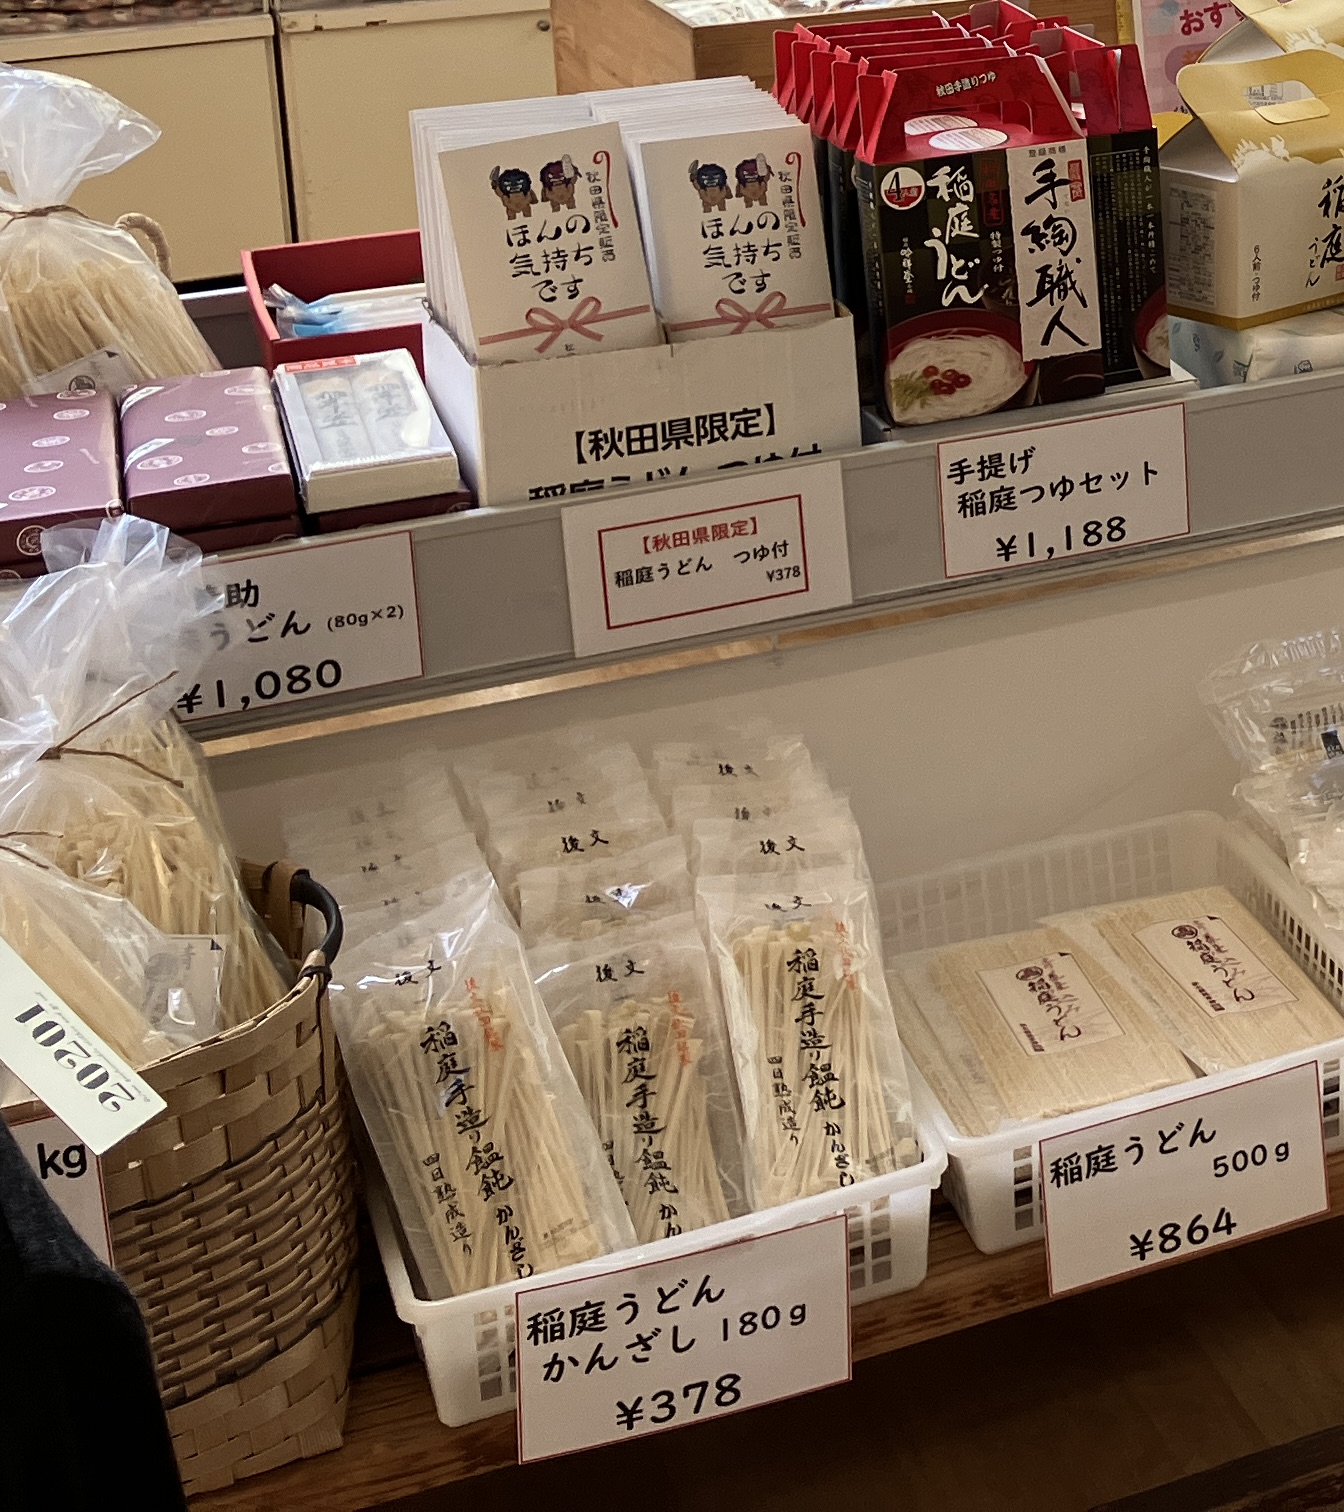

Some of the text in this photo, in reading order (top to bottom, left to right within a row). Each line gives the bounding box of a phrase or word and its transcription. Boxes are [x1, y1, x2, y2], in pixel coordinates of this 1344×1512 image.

[506, 213, 591, 247] ほんの
[702, 210, 781, 240] ほんの
[924, 165, 990, 307] 稲庭うどん
[509, 241, 595, 278] 気持ち
[703, 238, 783, 270] 気持ち
[531, 274, 584, 303] です
[722, 268, 772, 295] です
[574, 402, 777, 465] 【秋田県限定】
[946, 445, 1037, 485] 手提げ
[956, 460, 1160, 519] 稲庭つゆセット
[643, 516, 759, 555] 【秋田県限定】
[996, 515, 1127, 562] ¥1,188
[614, 540, 790, 589] 稲庭うどん つゆ付
[766, 565, 802, 583] ¥378
[177, 659, 342, 714] ¥1,080
[1048, 1118, 1218, 1190] 稲庭うどん
[1211, 1138, 1292, 1180] 500g
[1128, 1205, 1239, 1263] ¥864
[525, 1274, 726, 1348] 稲庭うどん
[542, 1302, 808, 1383] かんざし 180g
[614, 1371, 743, 1432] ¥378
